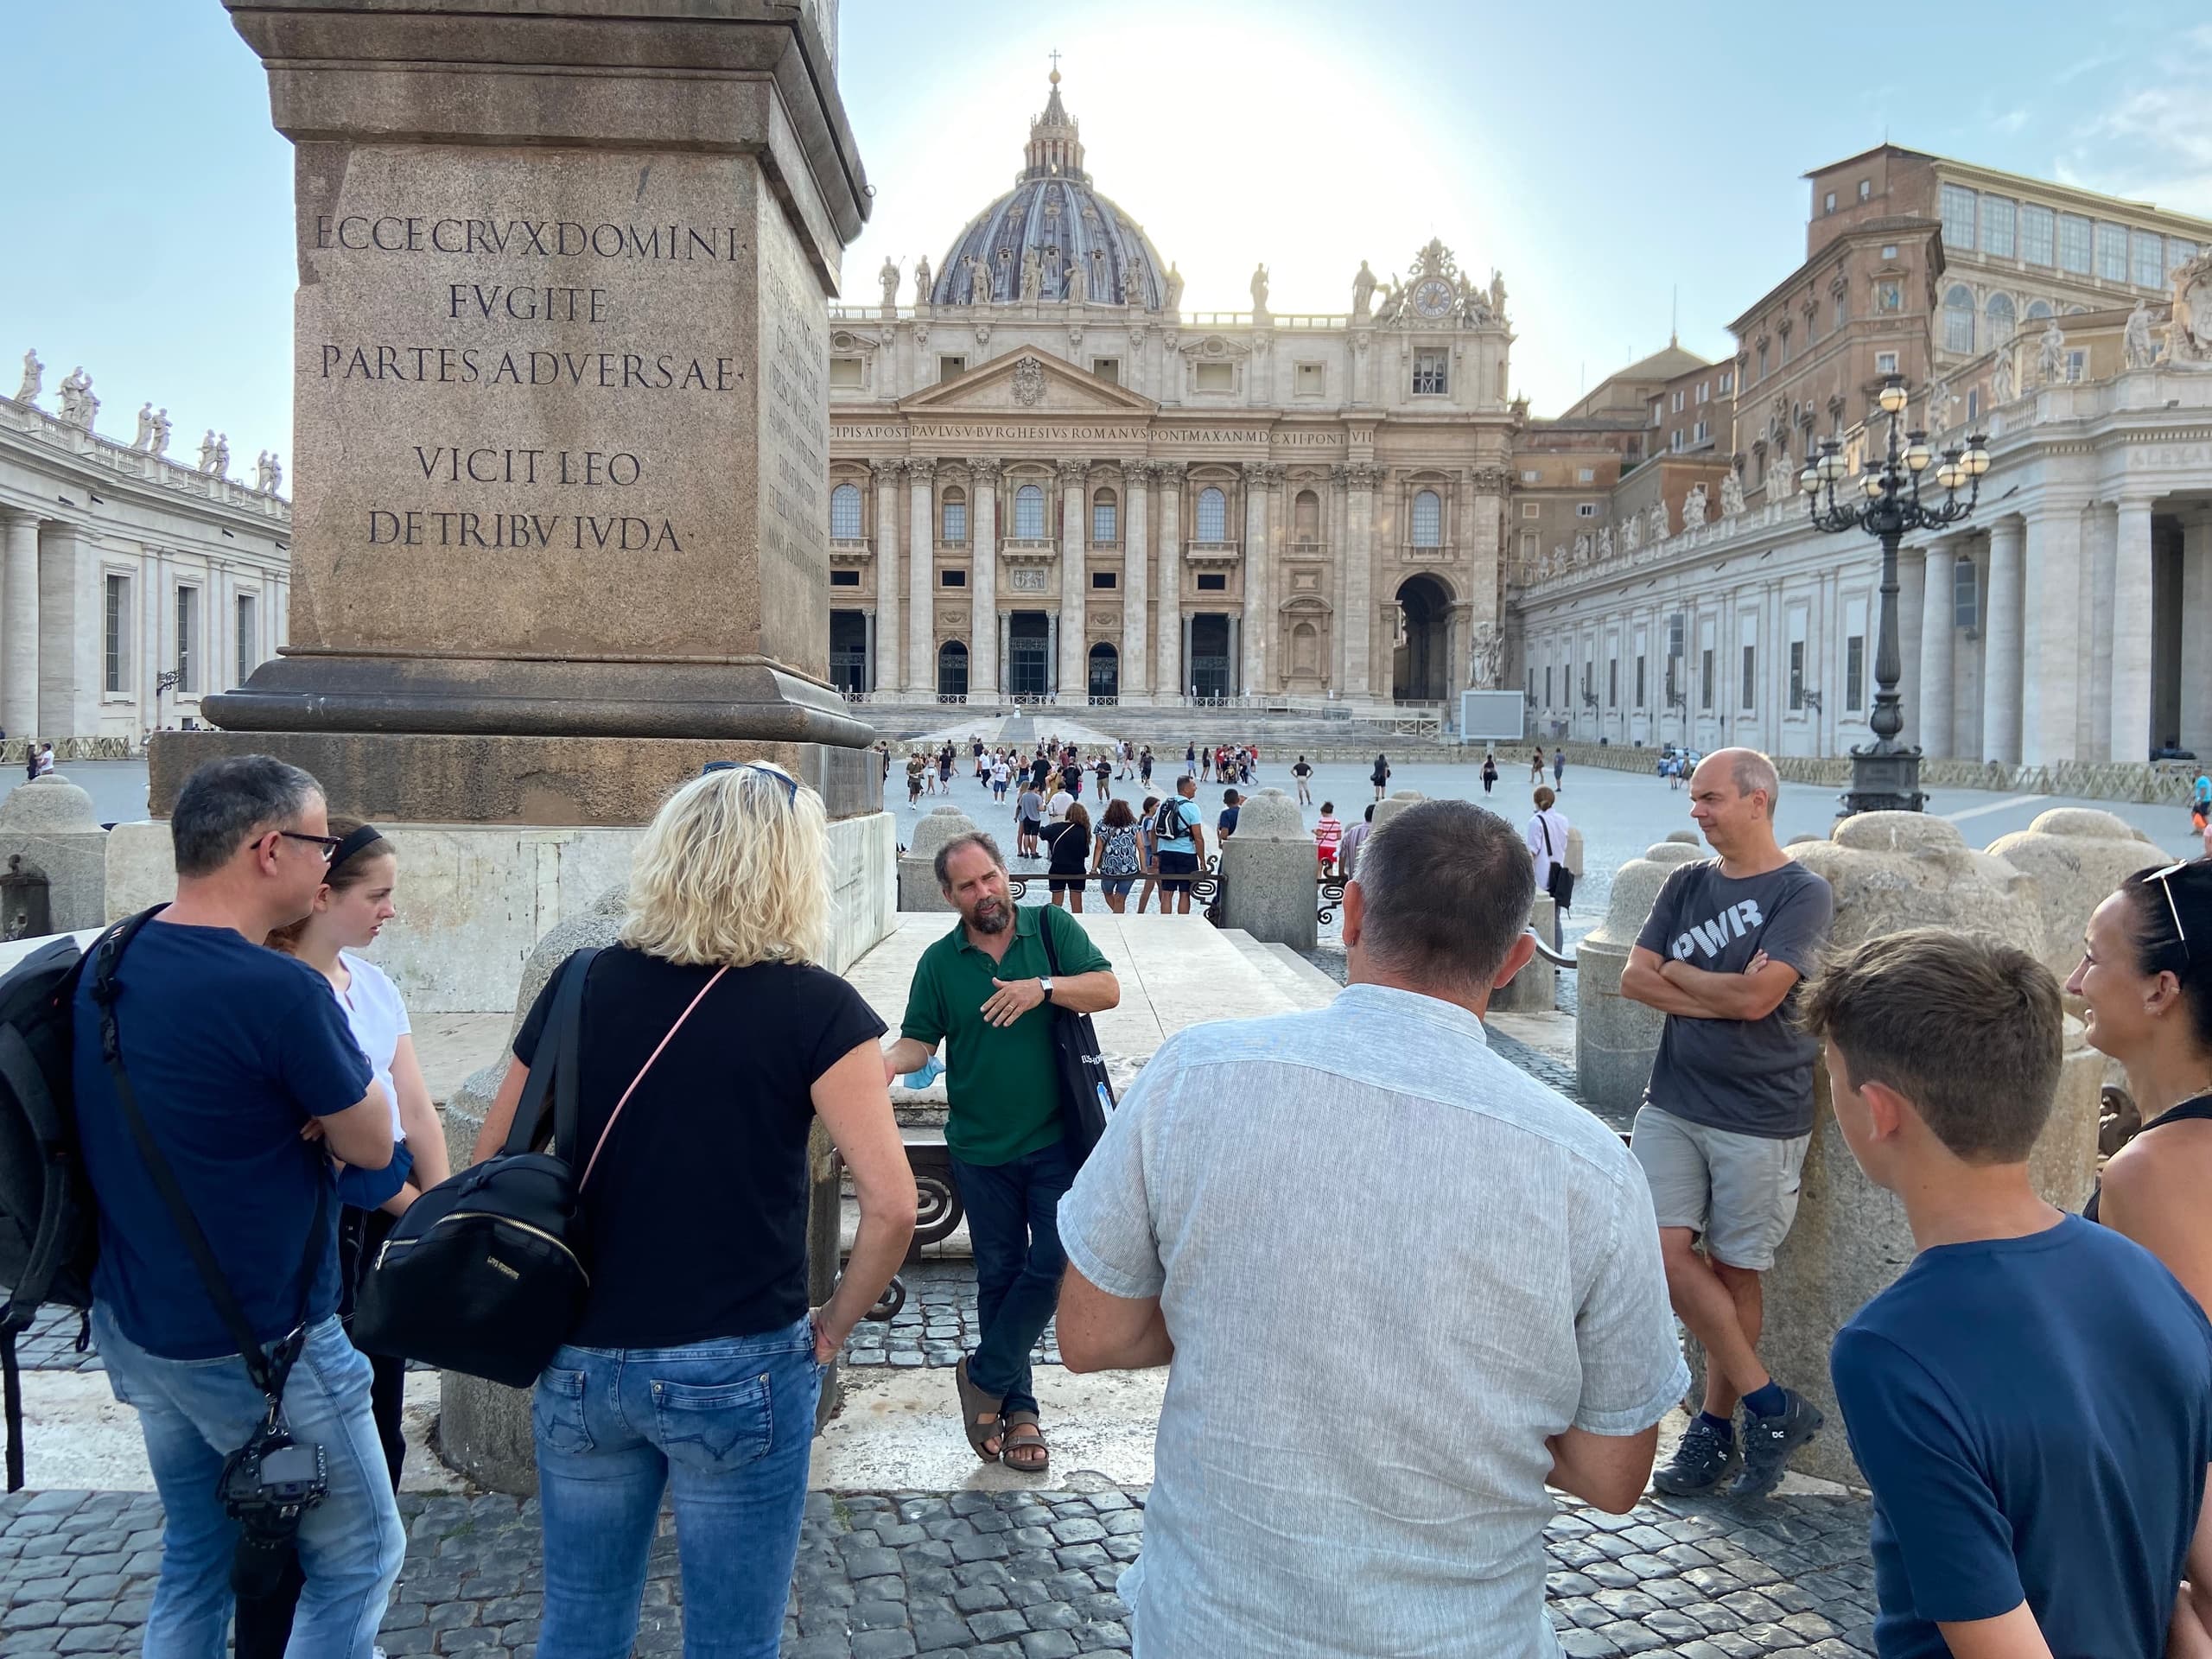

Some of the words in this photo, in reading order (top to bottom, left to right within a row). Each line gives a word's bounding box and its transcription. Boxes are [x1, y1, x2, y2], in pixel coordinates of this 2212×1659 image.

[448, 283, 607, 323] FVGITE
[321, 345, 480, 383] PARTES
[493, 352, 734, 391] ADVERSAE
[1071, 428, 1147, 440] ROMANVS
[1351, 431, 1372, 443] VII
[413, 446, 544, 484] VICIT
[558, 451, 641, 486] LEO
[1671, 898, 1764, 962] PWR
